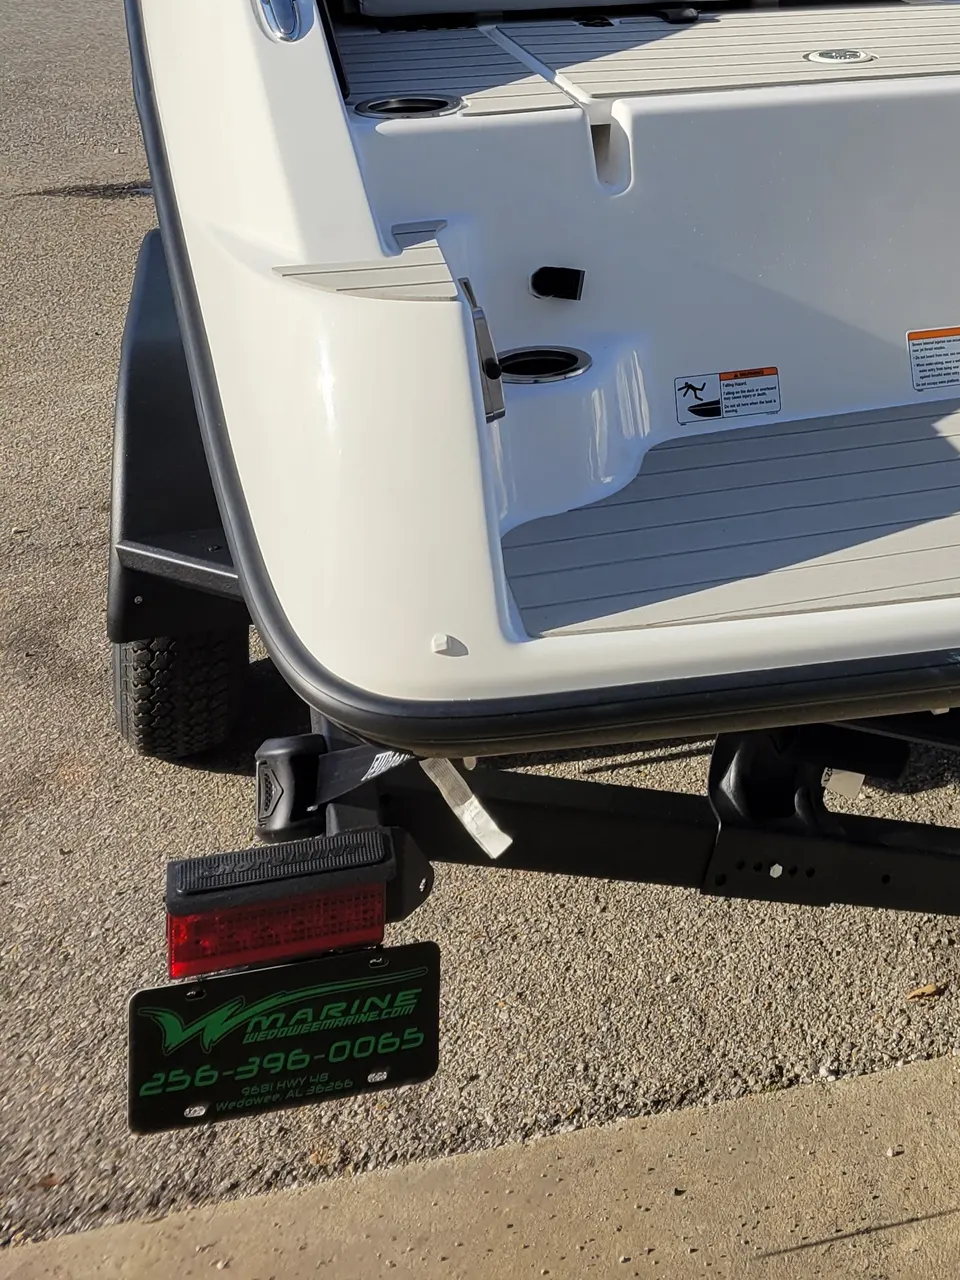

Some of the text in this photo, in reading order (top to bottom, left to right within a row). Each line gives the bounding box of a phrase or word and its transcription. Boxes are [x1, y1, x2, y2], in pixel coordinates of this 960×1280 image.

[242, 1004, 416, 1045] WEDOWEEMARINE.COM
[246, 988, 423, 1033] MARINE
[139, 1027, 425, 1097] 256-396-0065
[276, 1076, 307, 1090] HWY
[309, 1072, 329, 1083] 48
[215, 1078, 354, 1112] Wedowee, AL 36266
